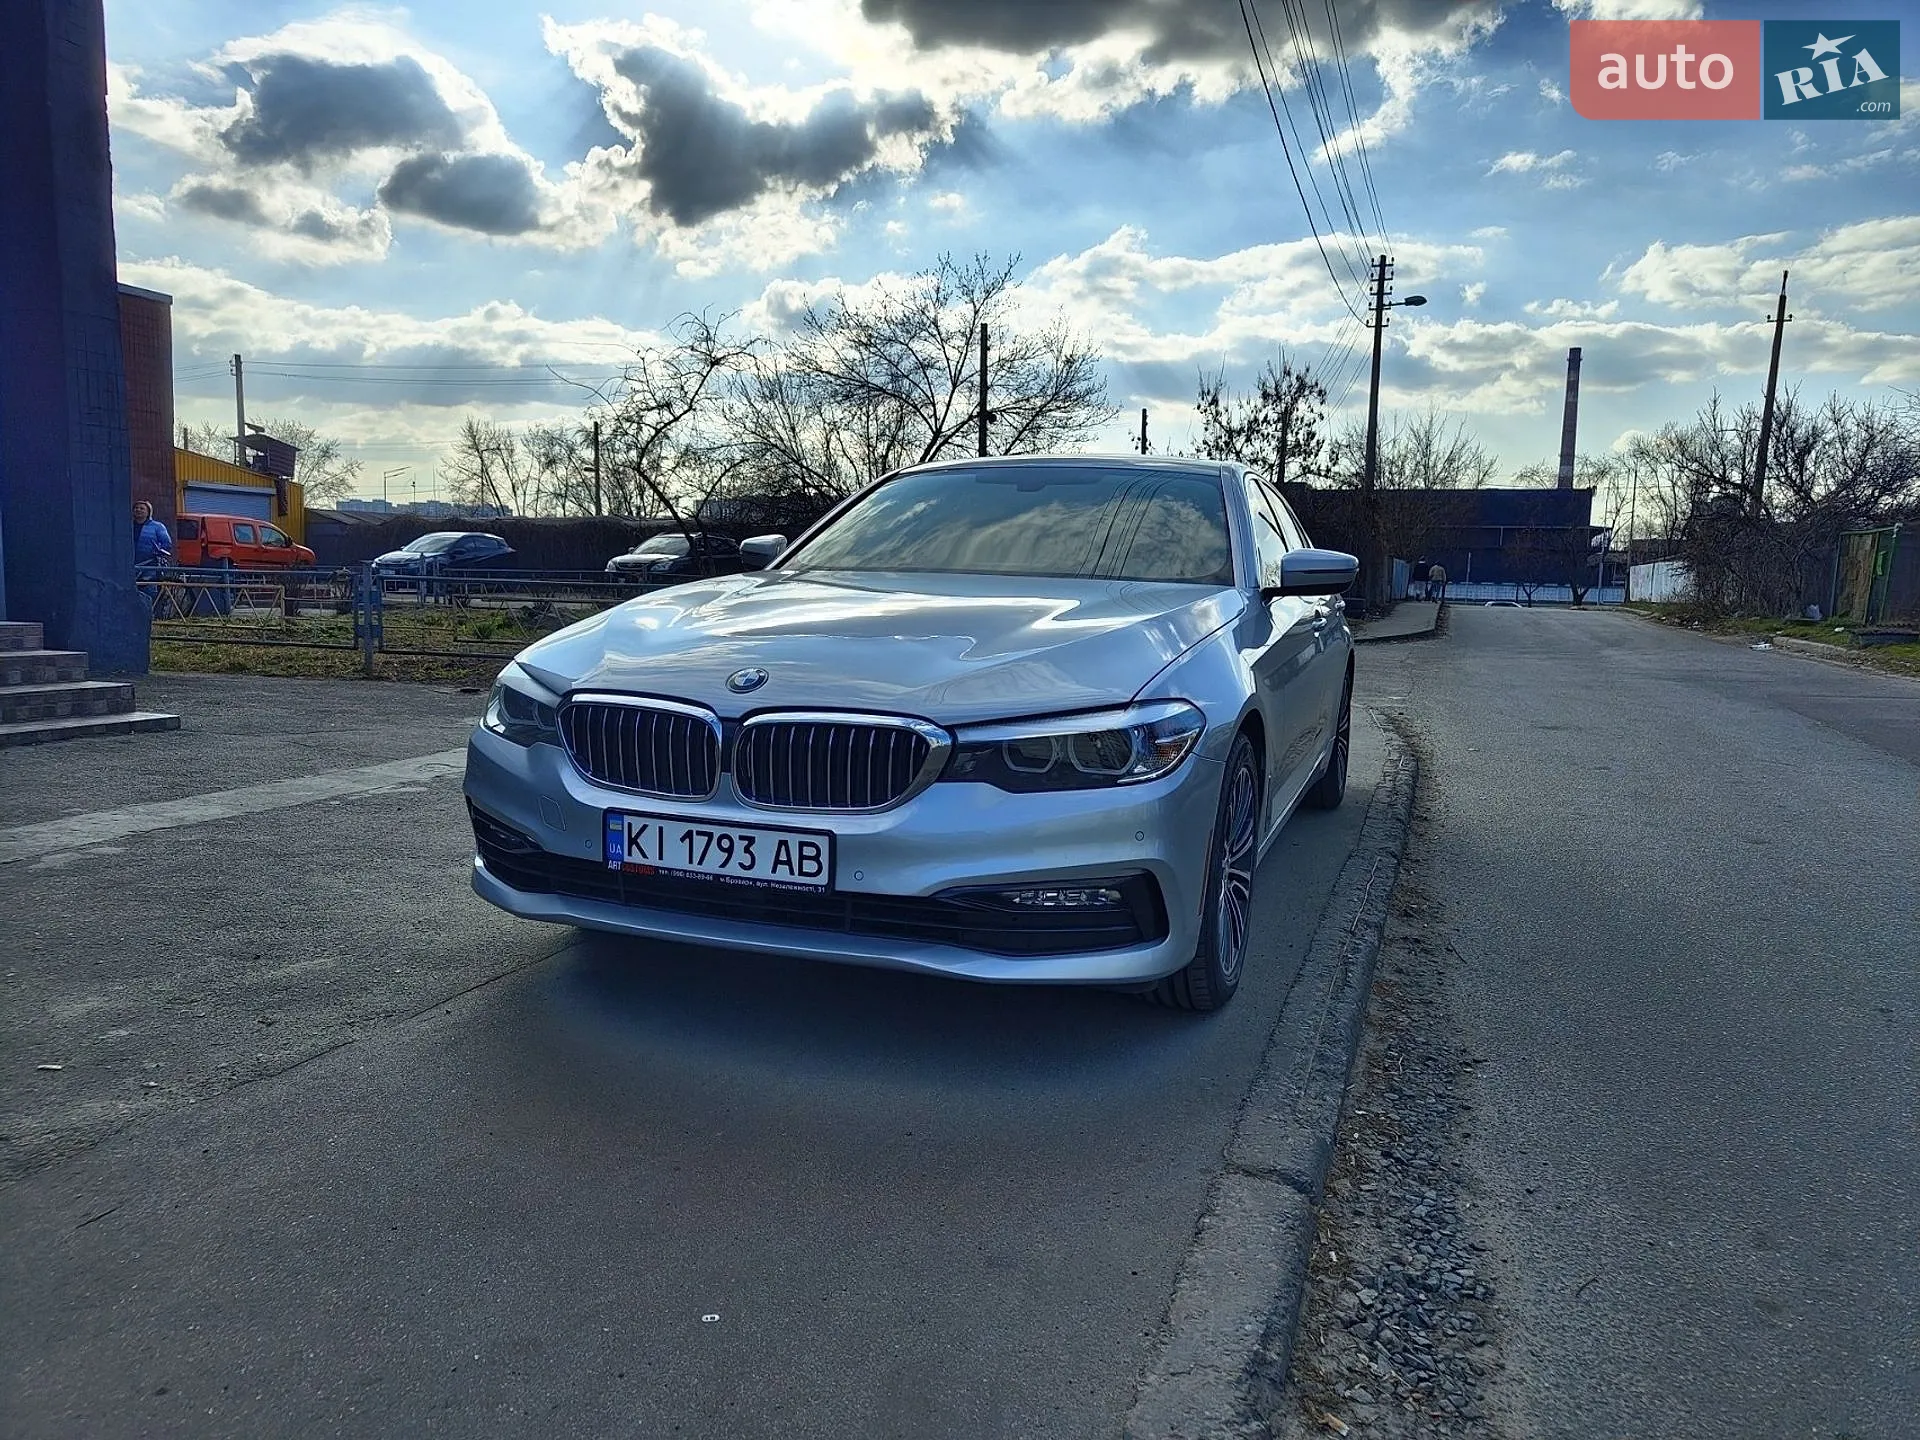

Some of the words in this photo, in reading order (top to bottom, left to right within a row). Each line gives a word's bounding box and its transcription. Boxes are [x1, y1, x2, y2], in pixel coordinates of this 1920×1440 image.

[609, 842, 622, 855] UA
[627, 821, 664, 861] KI
[679, 828, 757, 872] 1793
[771, 839, 823, 878] AB
